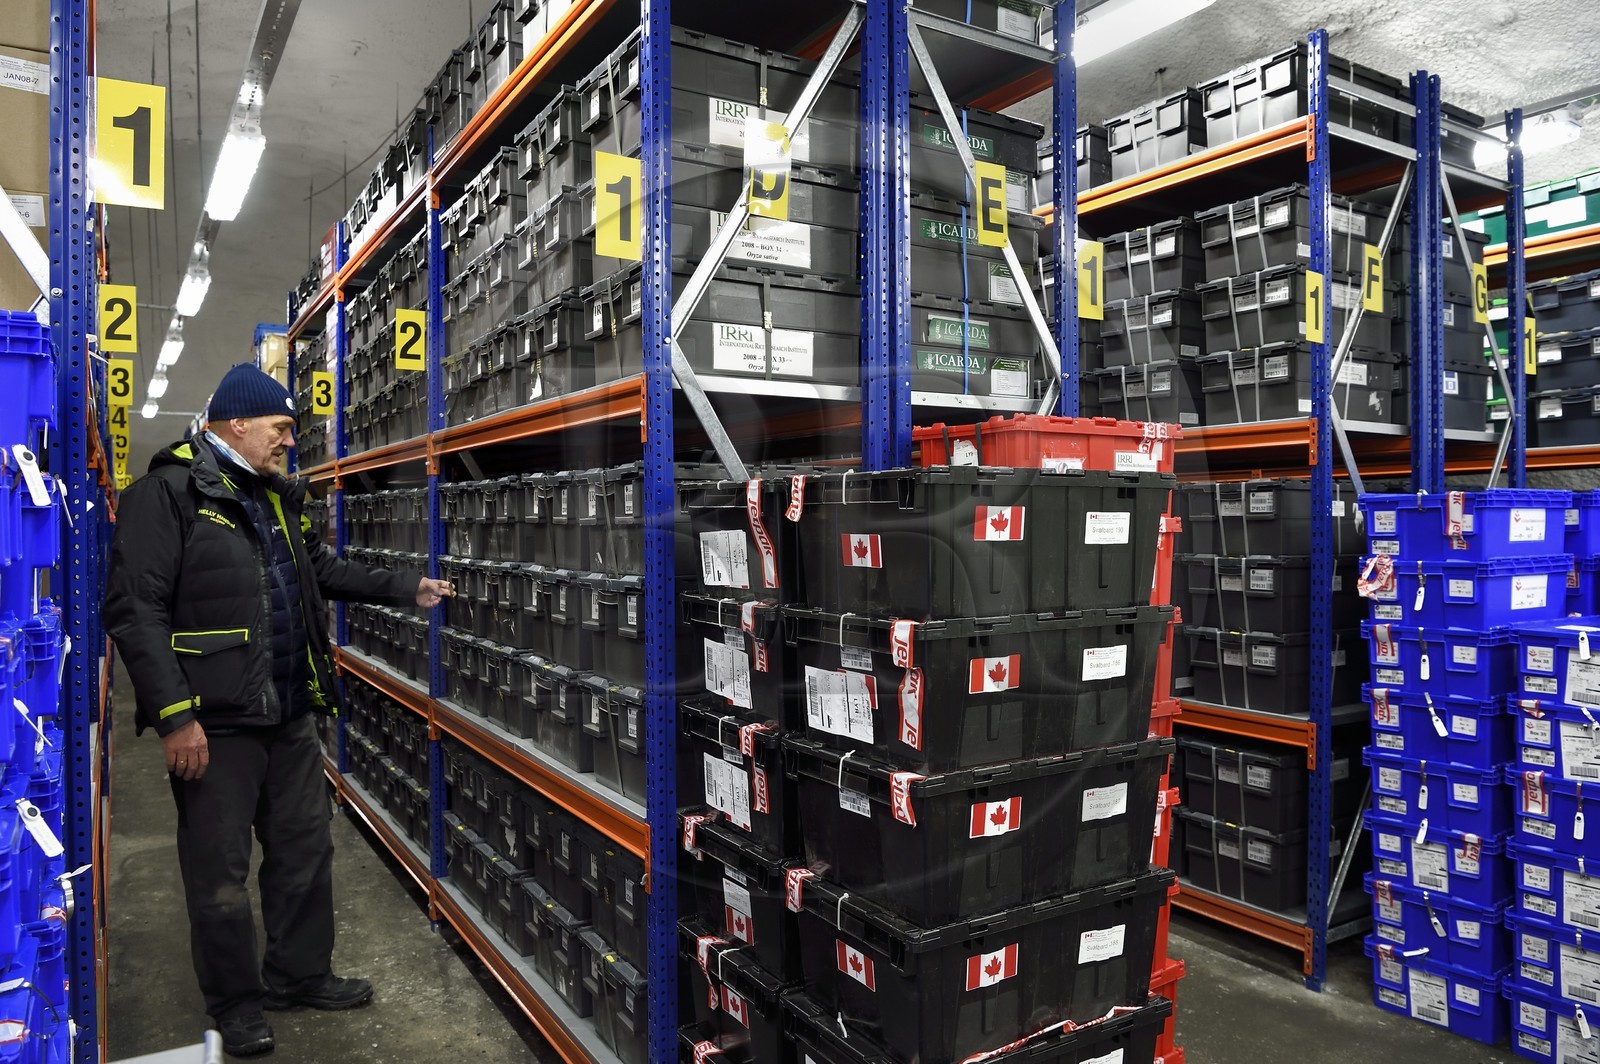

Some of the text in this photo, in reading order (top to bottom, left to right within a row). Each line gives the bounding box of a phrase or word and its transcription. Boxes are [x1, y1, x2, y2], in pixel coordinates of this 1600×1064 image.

[112, 106, 151, 188] 1
[606, 175, 632, 242] 1
[980, 176, 1004, 234] E
[741, 241, 755, 249] 2008
[760, 244, 774, 252] BOX
[746, 250, 762, 260] Oryza
[1082, 255, 1098, 306] 1
[1366, 256, 1380, 299] F
[1475, 273, 1487, 313] G
[105, 297, 132, 341] 2
[1309, 286, 1320, 331] 1
[400, 321, 422, 361] 2
[1525, 328, 1533, 365] 1
[110, 367, 130, 397] 3
[748, 363, 764, 371] Oryza
[315, 379, 332, 408] 3
[111, 406, 127, 429] 4
[1117, 454, 1133, 464] IRRI
[1092, 526, 1114, 534] Svalbard
